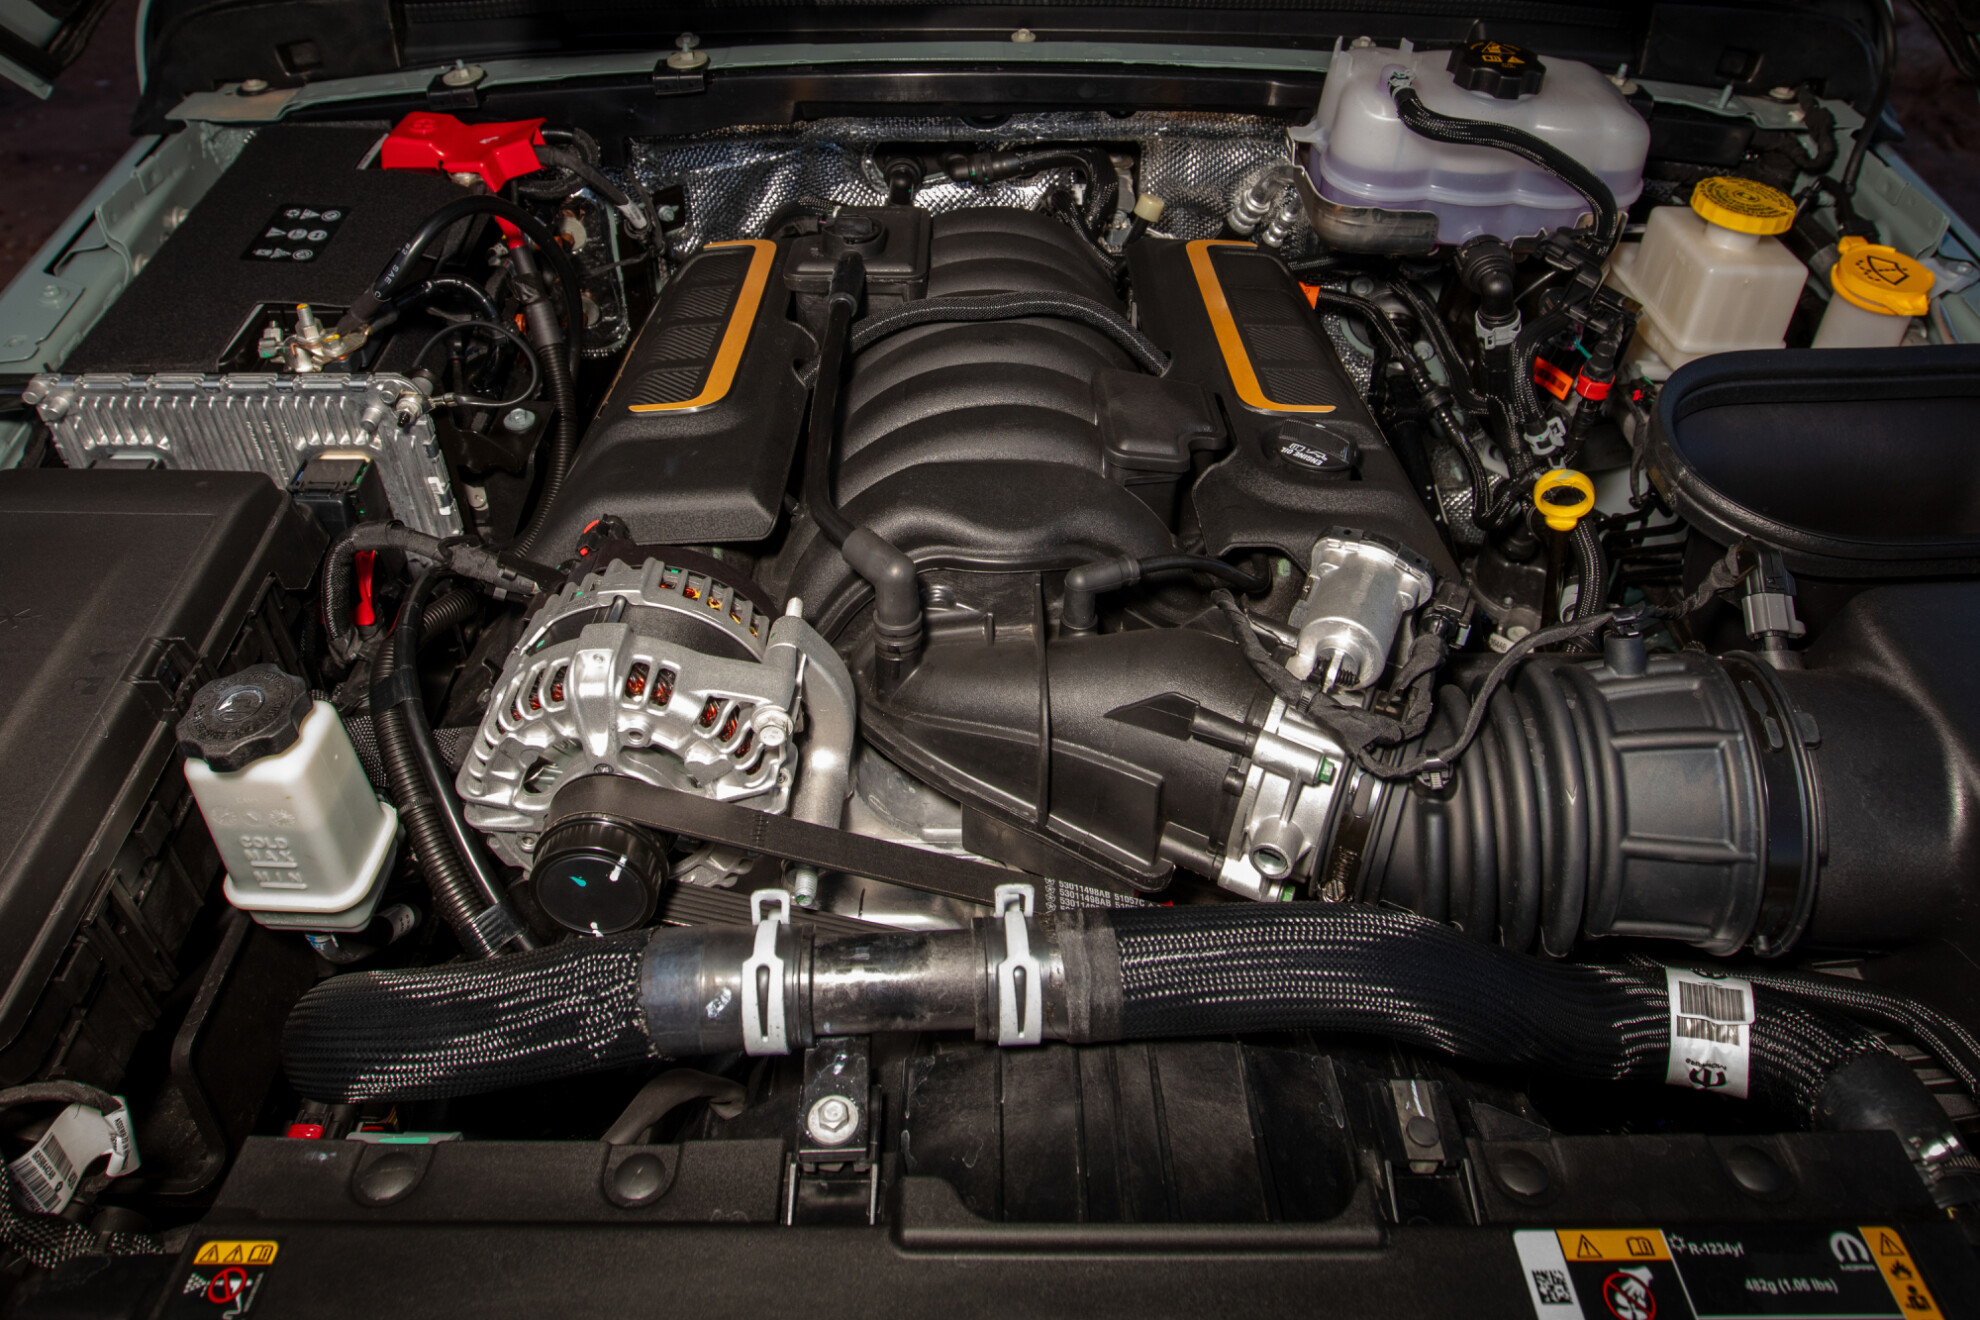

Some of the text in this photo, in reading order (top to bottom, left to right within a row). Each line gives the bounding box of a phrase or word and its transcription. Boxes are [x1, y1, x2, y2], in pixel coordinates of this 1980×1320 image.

[384, 265, 399, 284] SAE
[1281, 447, 1323, 466] ENGINE OIL
[239, 835, 288, 849] COLD
[243, 849, 295, 862] MAX
[253, 871, 303, 884] MIN
[1058, 880, 1145, 907] 53011498AB 51057C
[1059, 888, 1112, 907] 53011498AB
[1688, 1242, 1745, 1258] R-1234yf
[1745, 1278, 1778, 1295] 482g
[1810, 1278, 1838, 1295] lbs)
